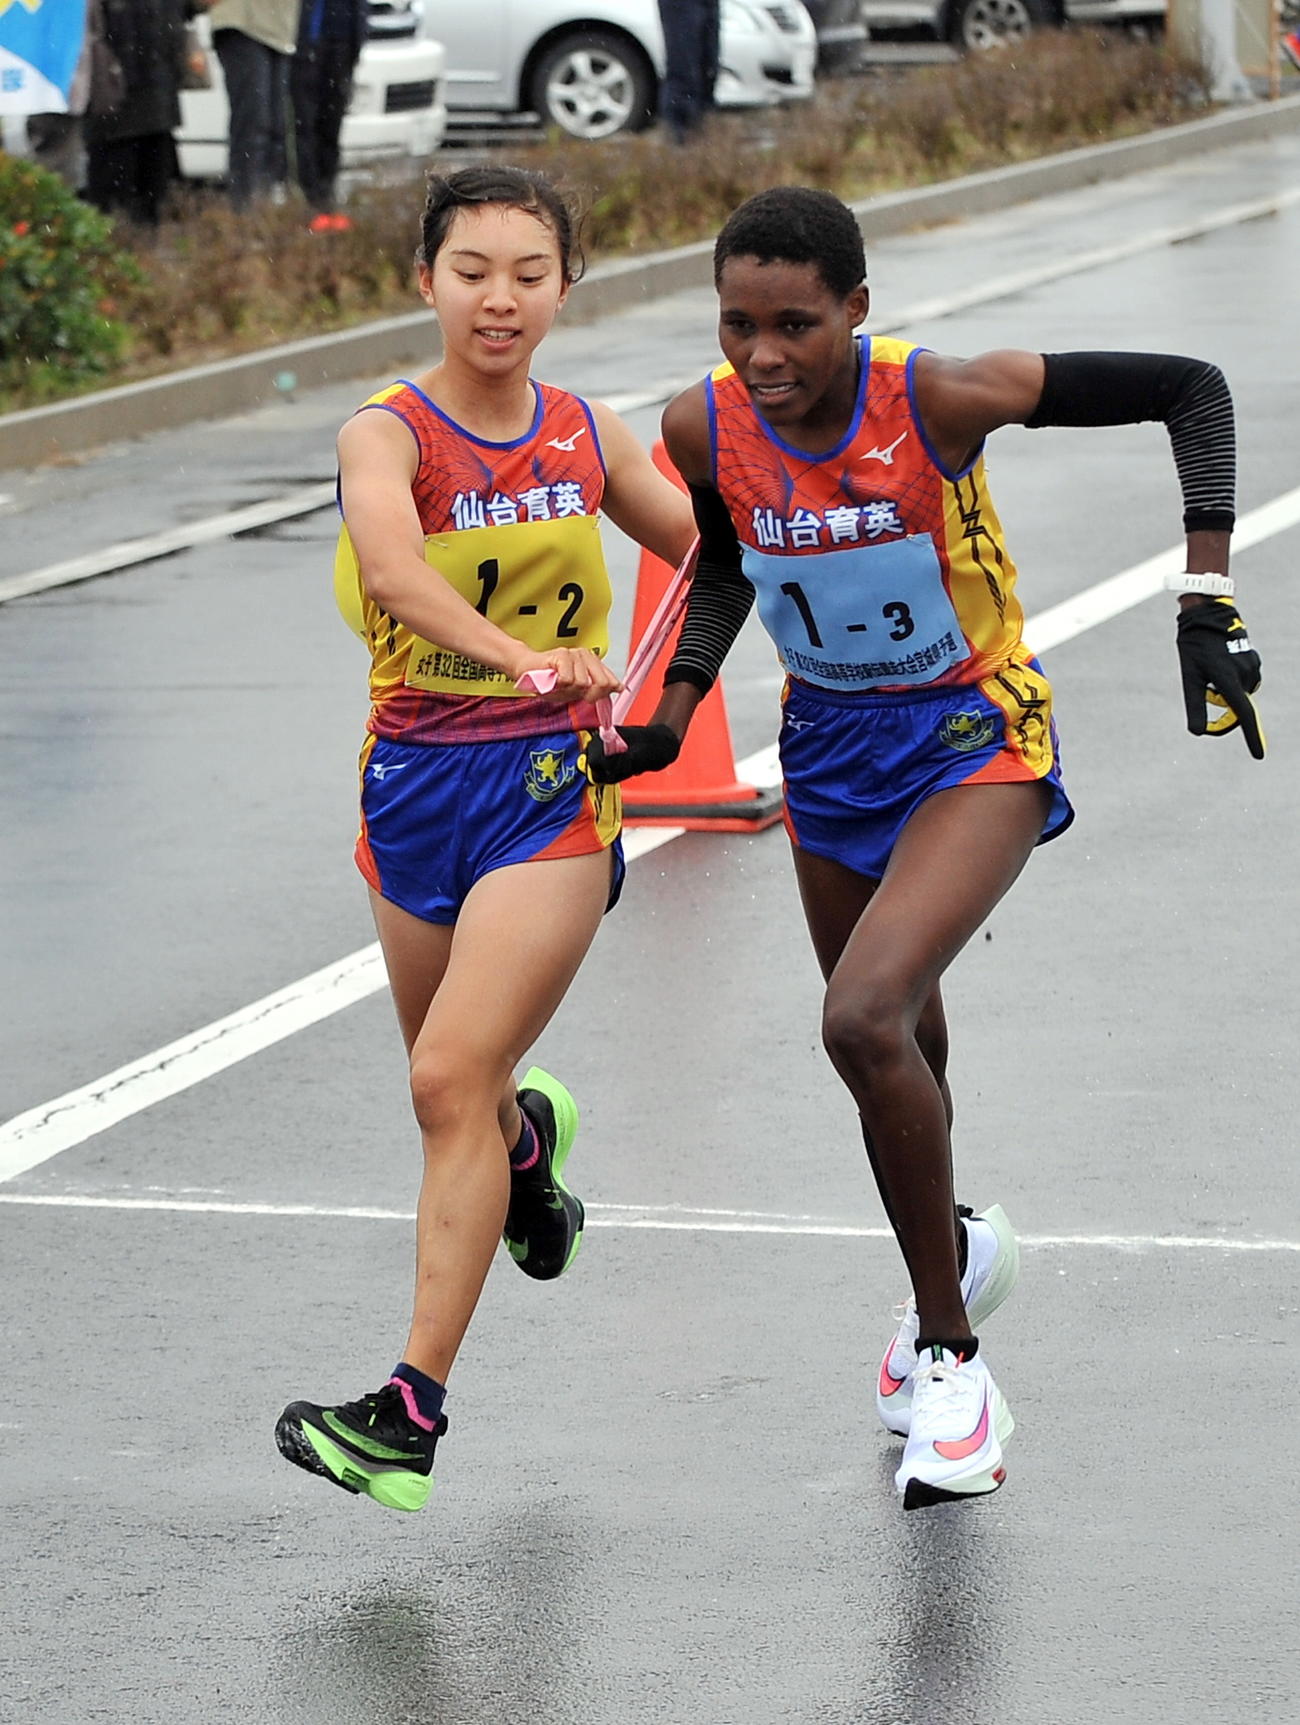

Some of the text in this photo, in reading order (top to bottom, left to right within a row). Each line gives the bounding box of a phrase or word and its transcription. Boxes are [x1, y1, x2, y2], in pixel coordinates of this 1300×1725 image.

[451, 482, 586, 530] 仙台育英
[752, 500, 905, 548] 仙台育英
